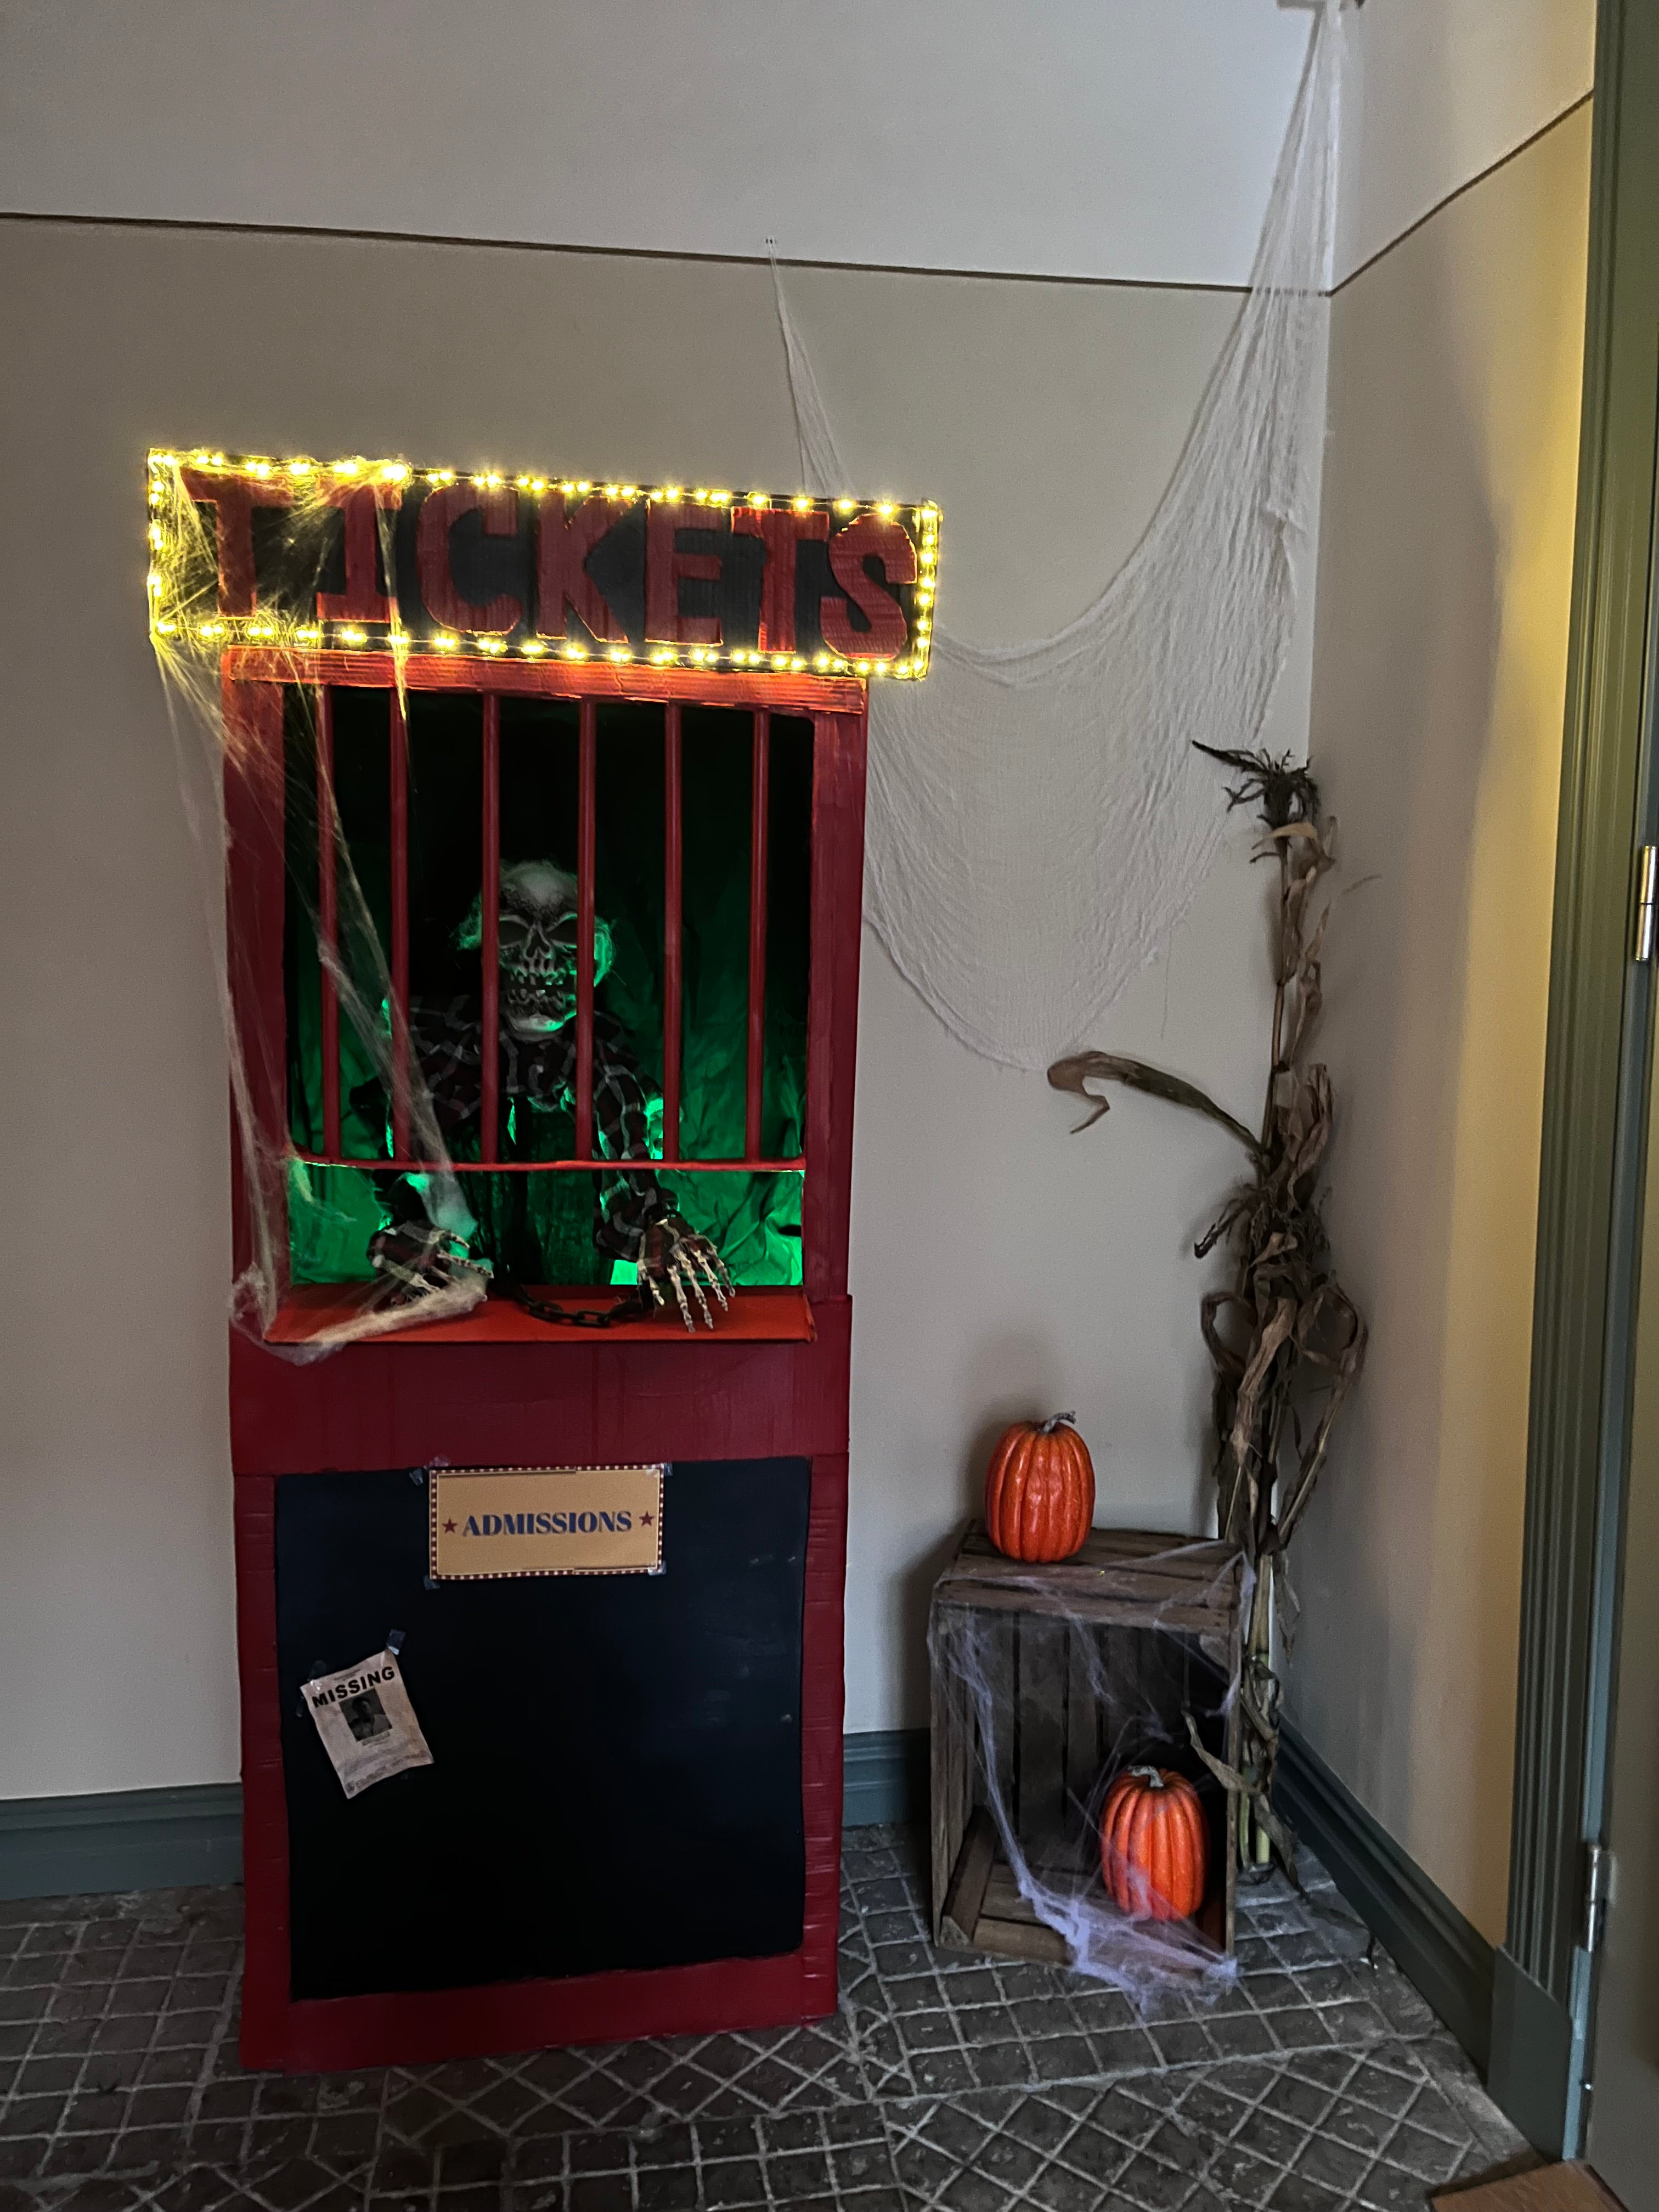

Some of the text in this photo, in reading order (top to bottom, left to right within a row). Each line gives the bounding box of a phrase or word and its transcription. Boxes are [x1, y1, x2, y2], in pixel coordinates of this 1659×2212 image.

[180, 466, 918, 661] TICKETS
[462, 1510, 632, 1537] ADMISSIONS
[312, 1666, 395, 1708] MISSING
